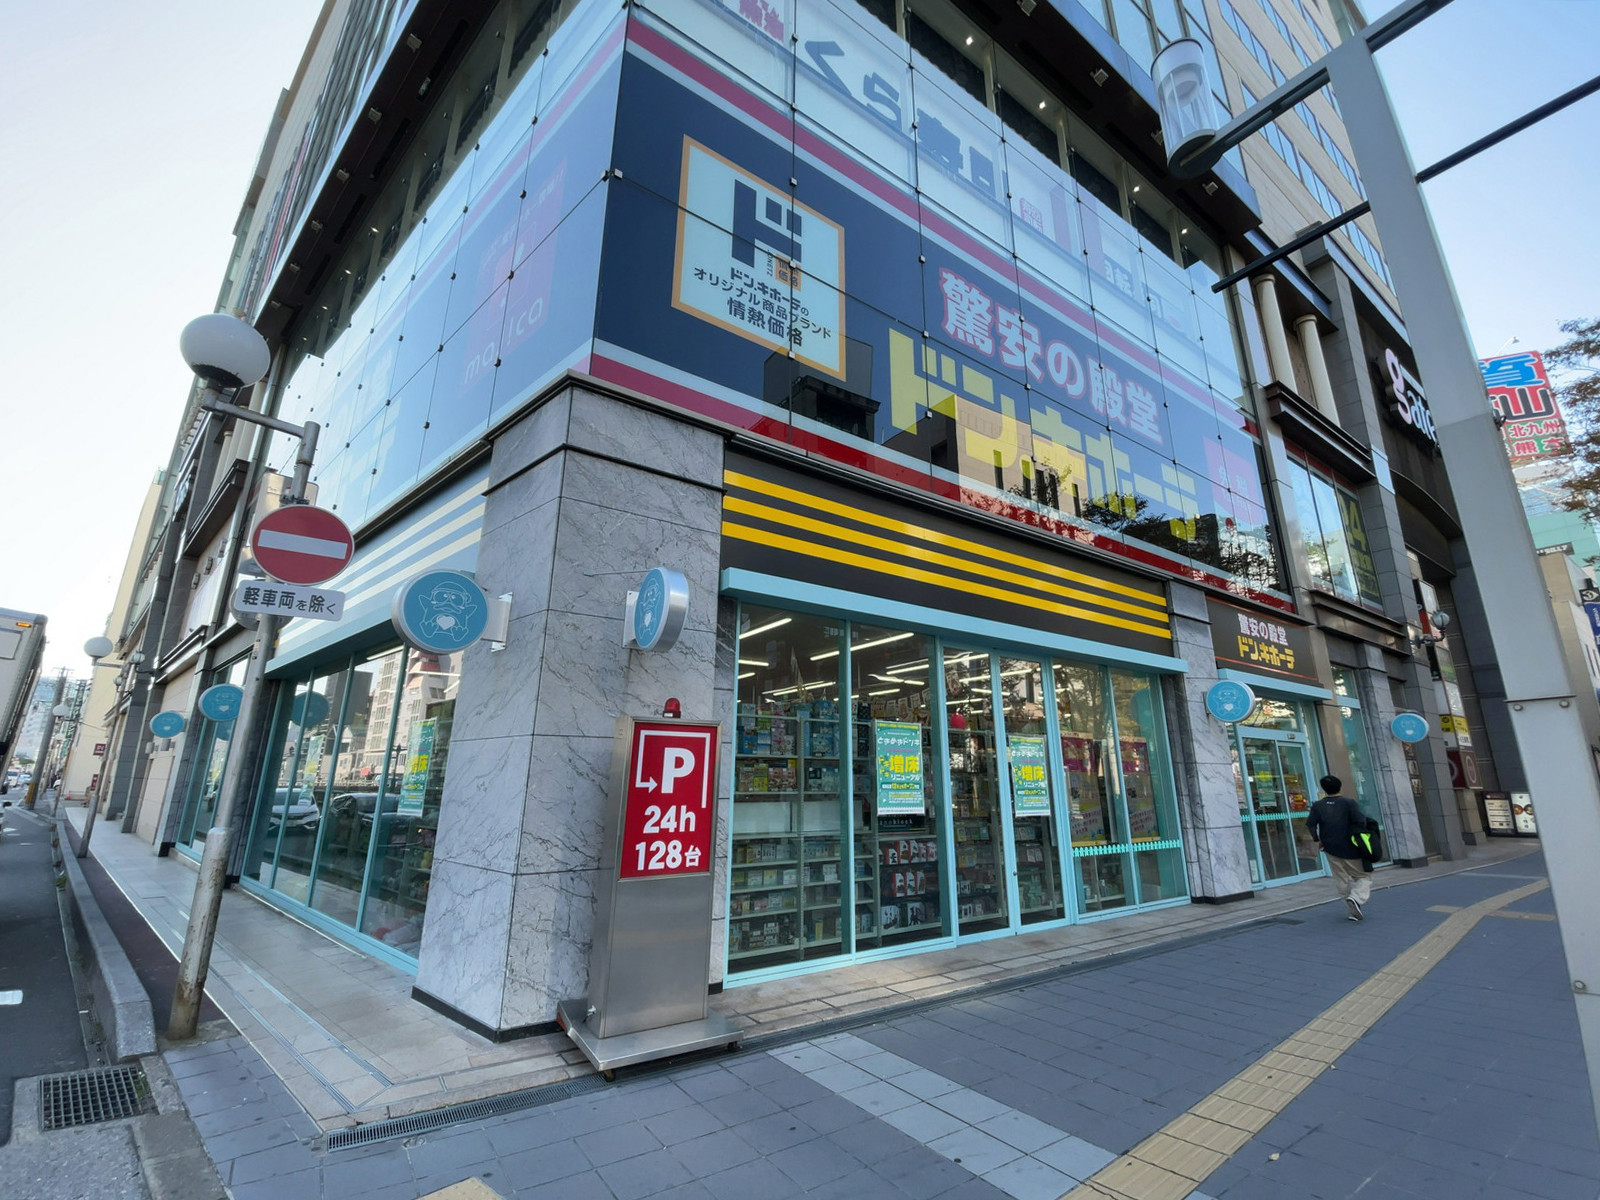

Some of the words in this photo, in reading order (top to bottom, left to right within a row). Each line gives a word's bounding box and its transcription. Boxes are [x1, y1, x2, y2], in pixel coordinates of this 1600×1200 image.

[732, 178, 802, 268] ド
[693, 266, 832, 339] オリジナル商品ブランド
[727, 297, 803, 347] 情熱価格
[463, 297, 544, 386] maica
[940, 267, 1163, 445] 驚安の殿堂
[1509, 419, 1560, 439] 北九州
[242, 586, 336, 615] 軽車両を除く
[1237, 612, 1289, 646] 驚安の殿堂
[661, 747, 696, 794] P
[889, 755, 920, 773] 増床
[643, 804, 697, 834] 24h
[635, 839, 701, 871] 128台
